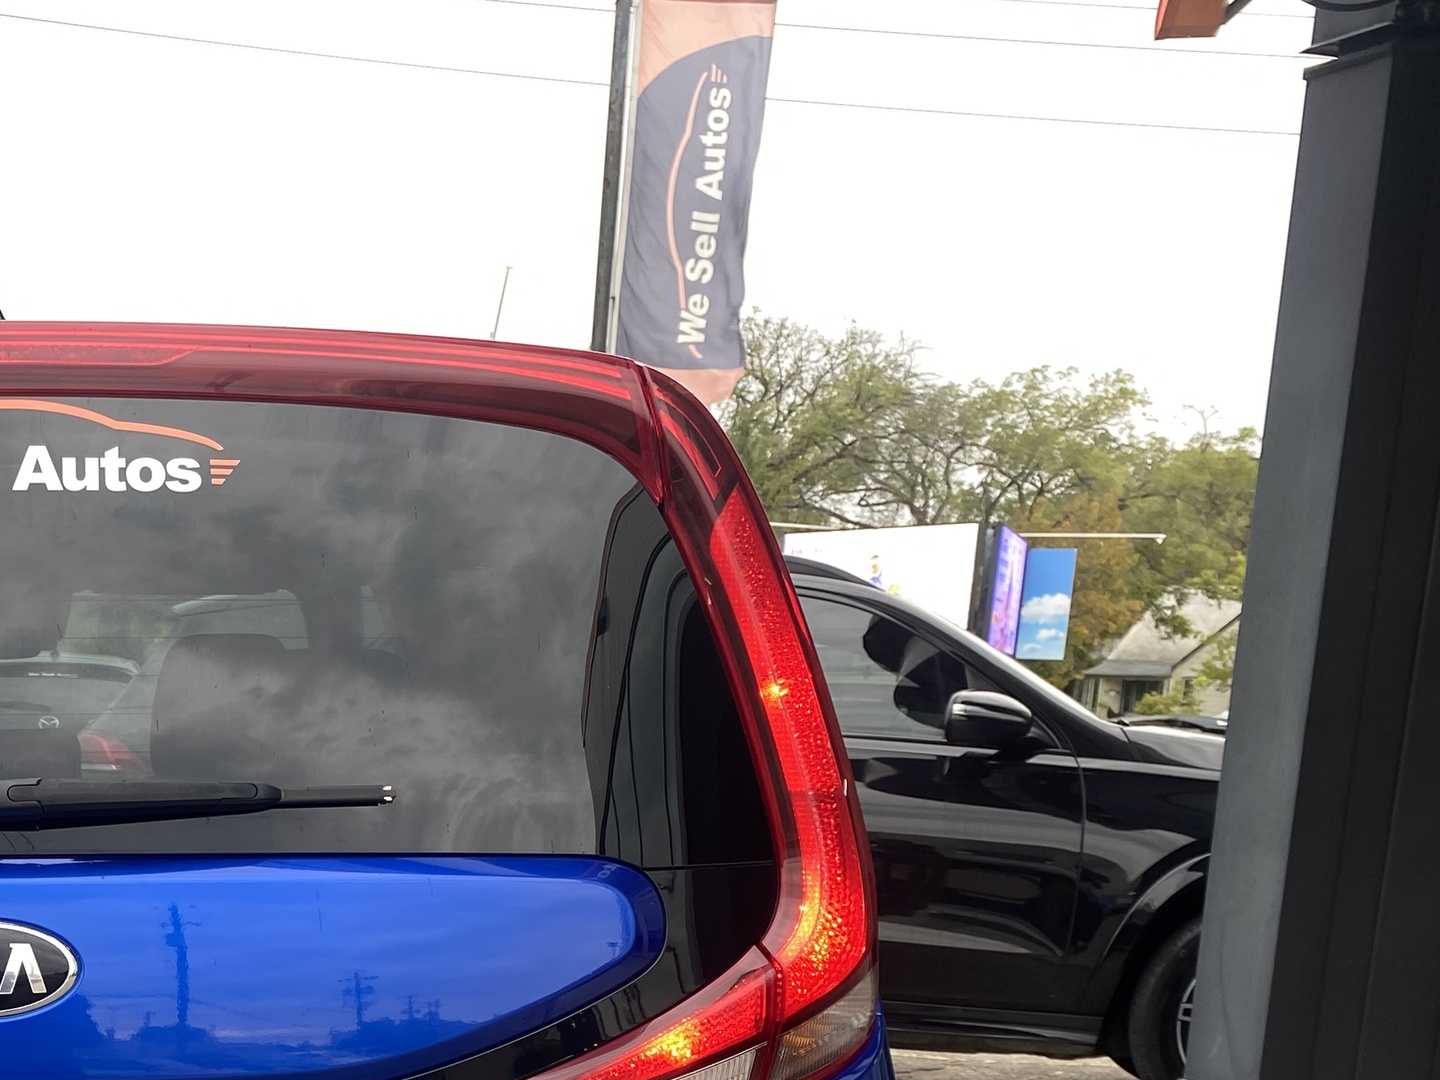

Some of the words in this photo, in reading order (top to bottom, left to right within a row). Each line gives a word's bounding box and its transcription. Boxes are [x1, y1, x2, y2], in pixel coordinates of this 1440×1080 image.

[695, 86, 732, 201] Autos
[685, 211, 721, 285] Sell
[676, 294, 710, 345] We
[12, 445, 202, 493] Autos
